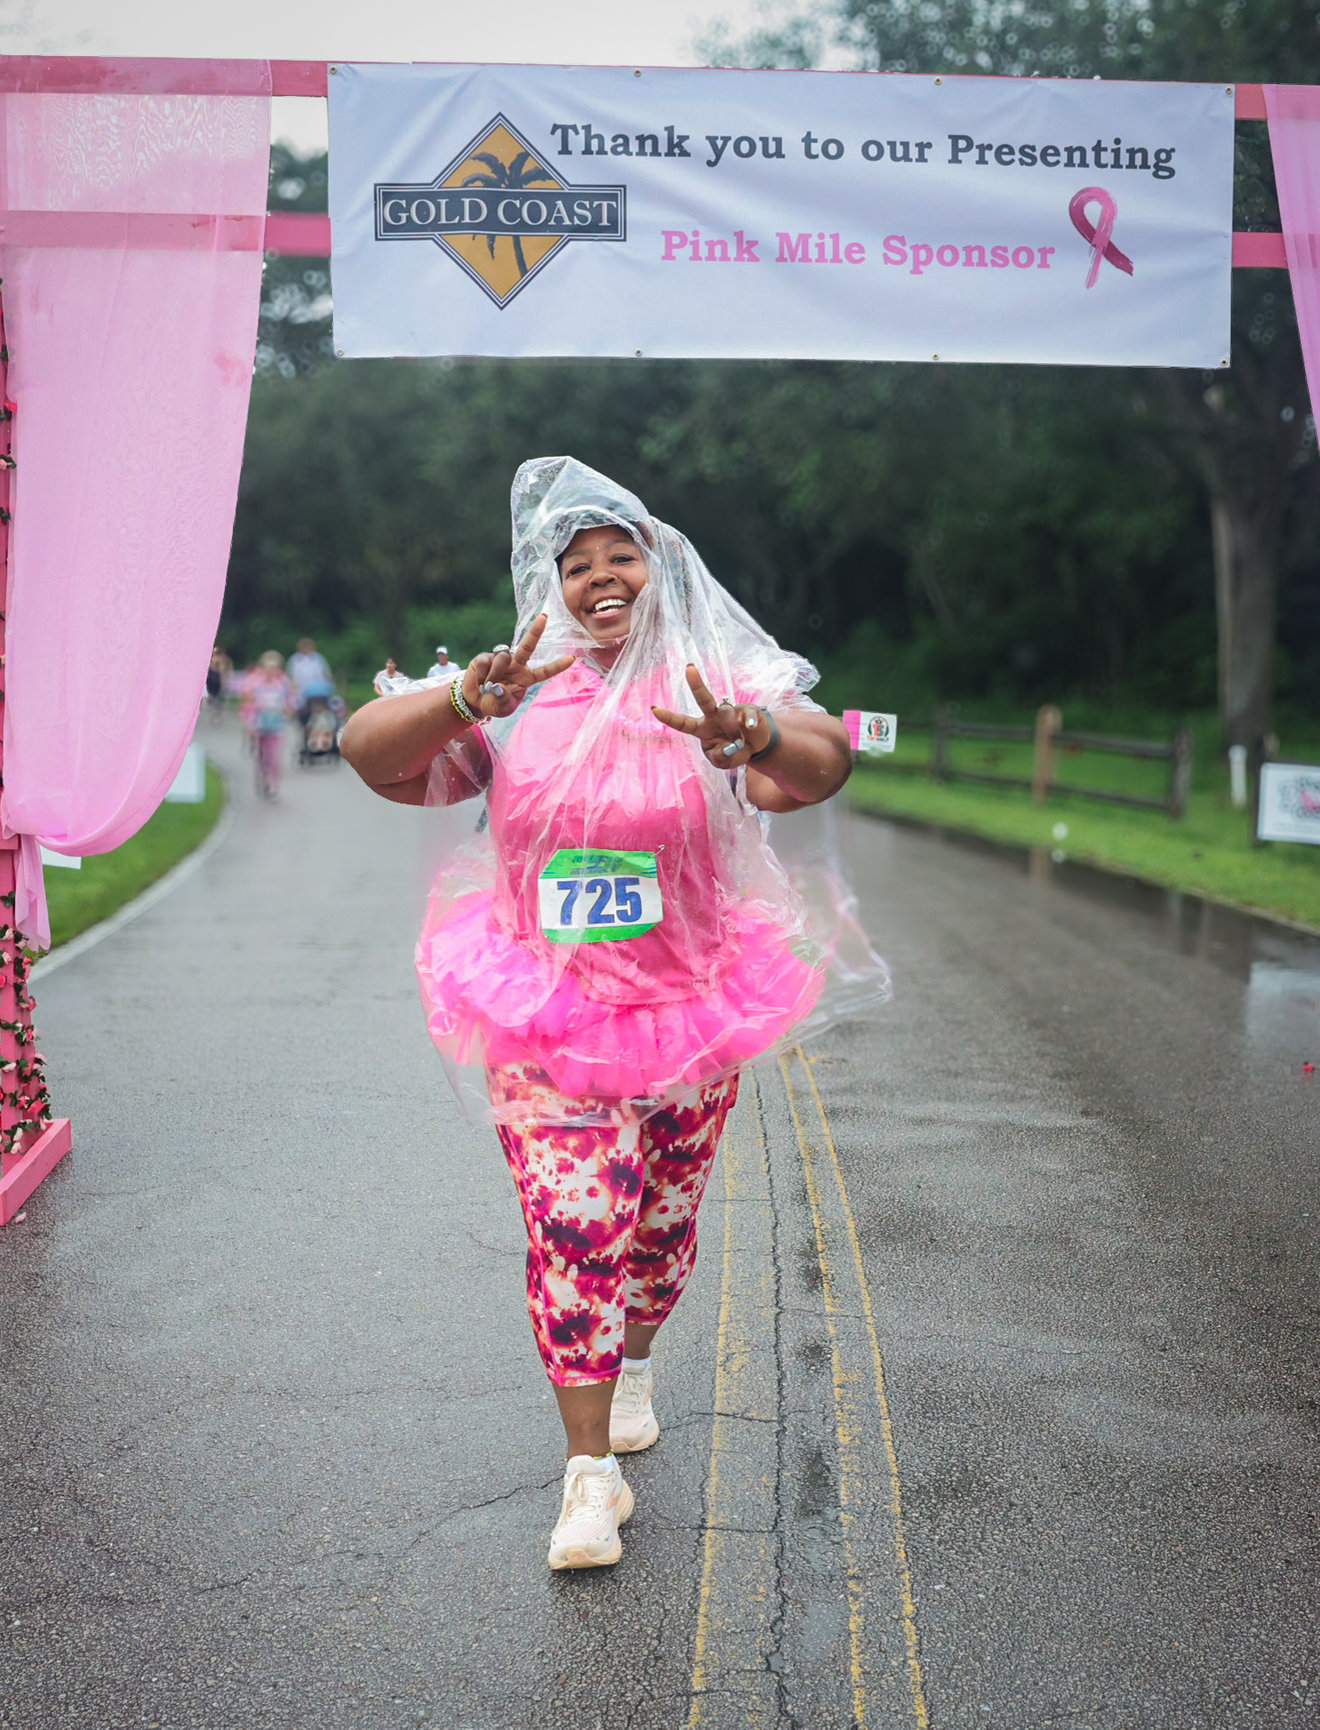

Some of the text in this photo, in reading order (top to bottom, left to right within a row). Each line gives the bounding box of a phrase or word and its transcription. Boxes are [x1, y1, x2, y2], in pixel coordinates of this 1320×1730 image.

[550, 123, 1177, 180] Thank you to our Presenting
[382, 197, 617, 227] GOLD COAST
[661, 230, 1056, 275] Pink Mile Sponsor
[556, 877, 643, 926] 725
